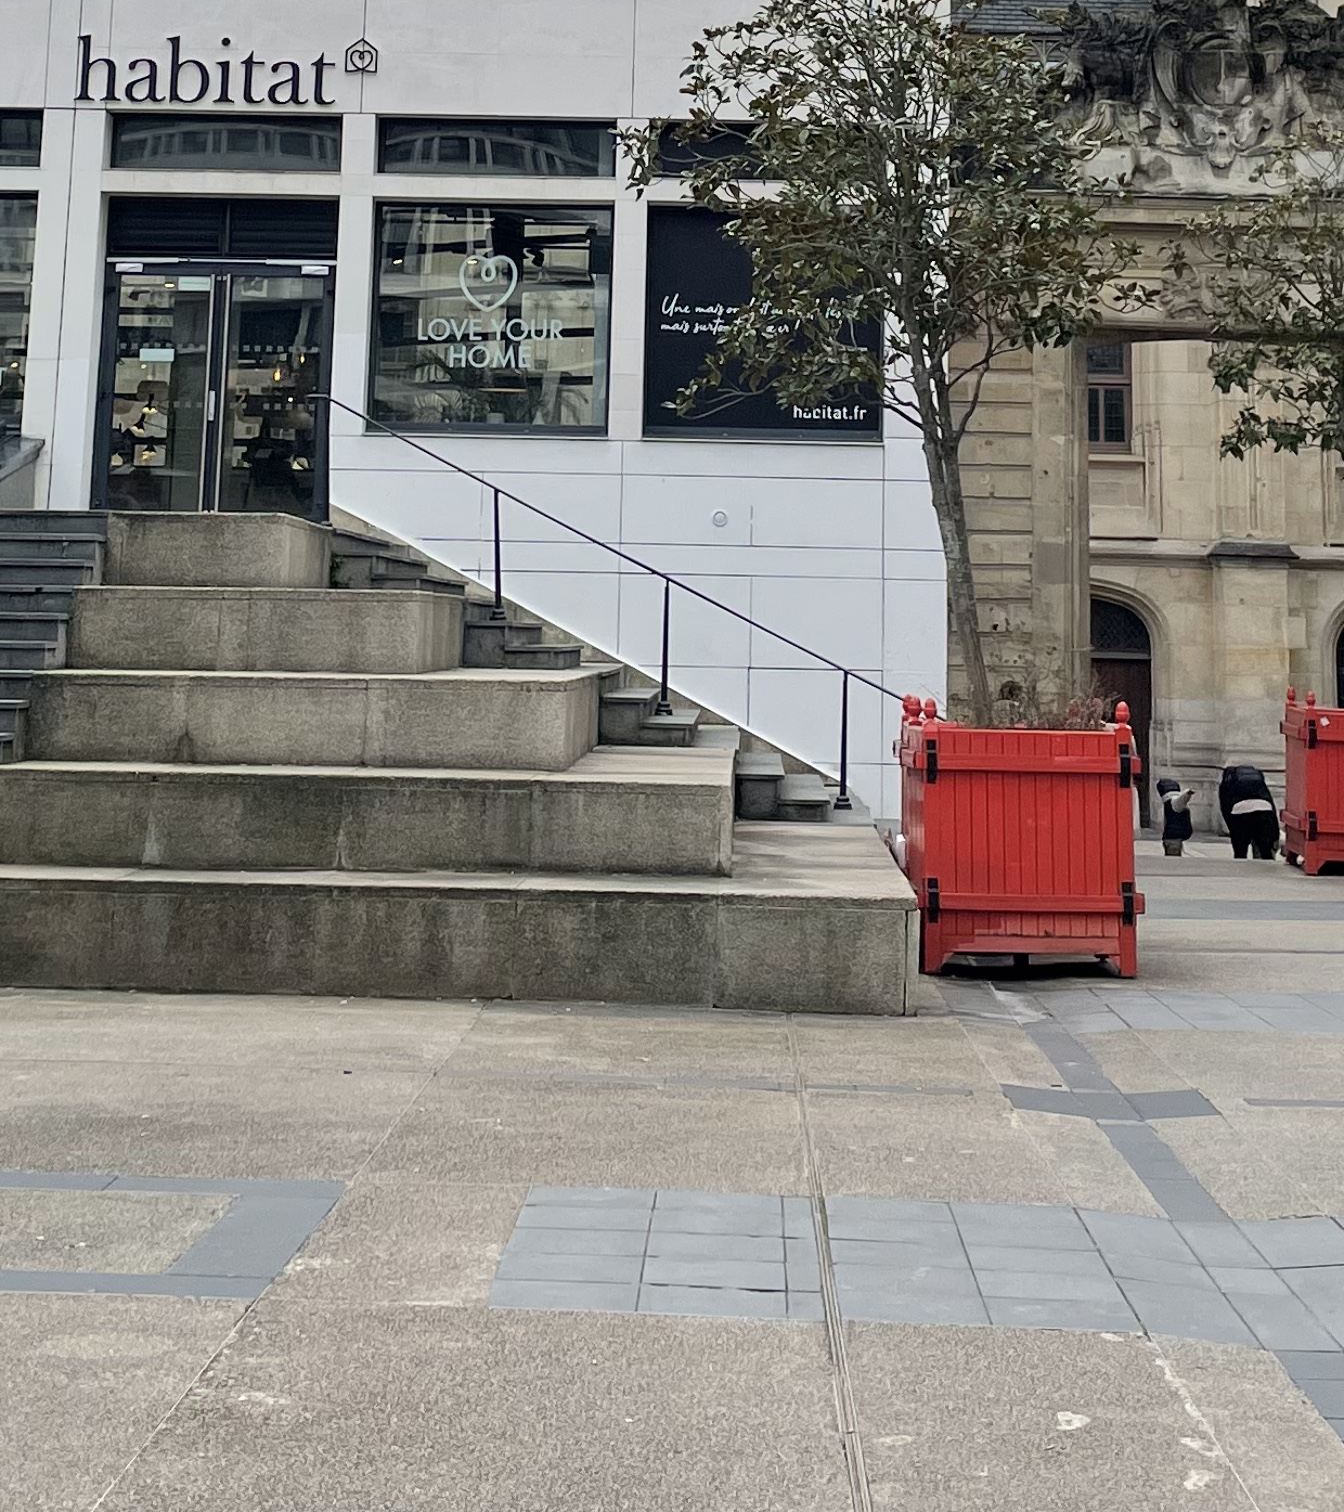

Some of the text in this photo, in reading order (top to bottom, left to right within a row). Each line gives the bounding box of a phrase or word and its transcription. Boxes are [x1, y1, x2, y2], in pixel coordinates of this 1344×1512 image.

[74, 34, 336, 105] habitat
[661, 293, 691, 317] Une
[417, 319, 565, 342] LOVE YOUR
[660, 320, 690, 334] mais
[449, 345, 533, 368] HOME
